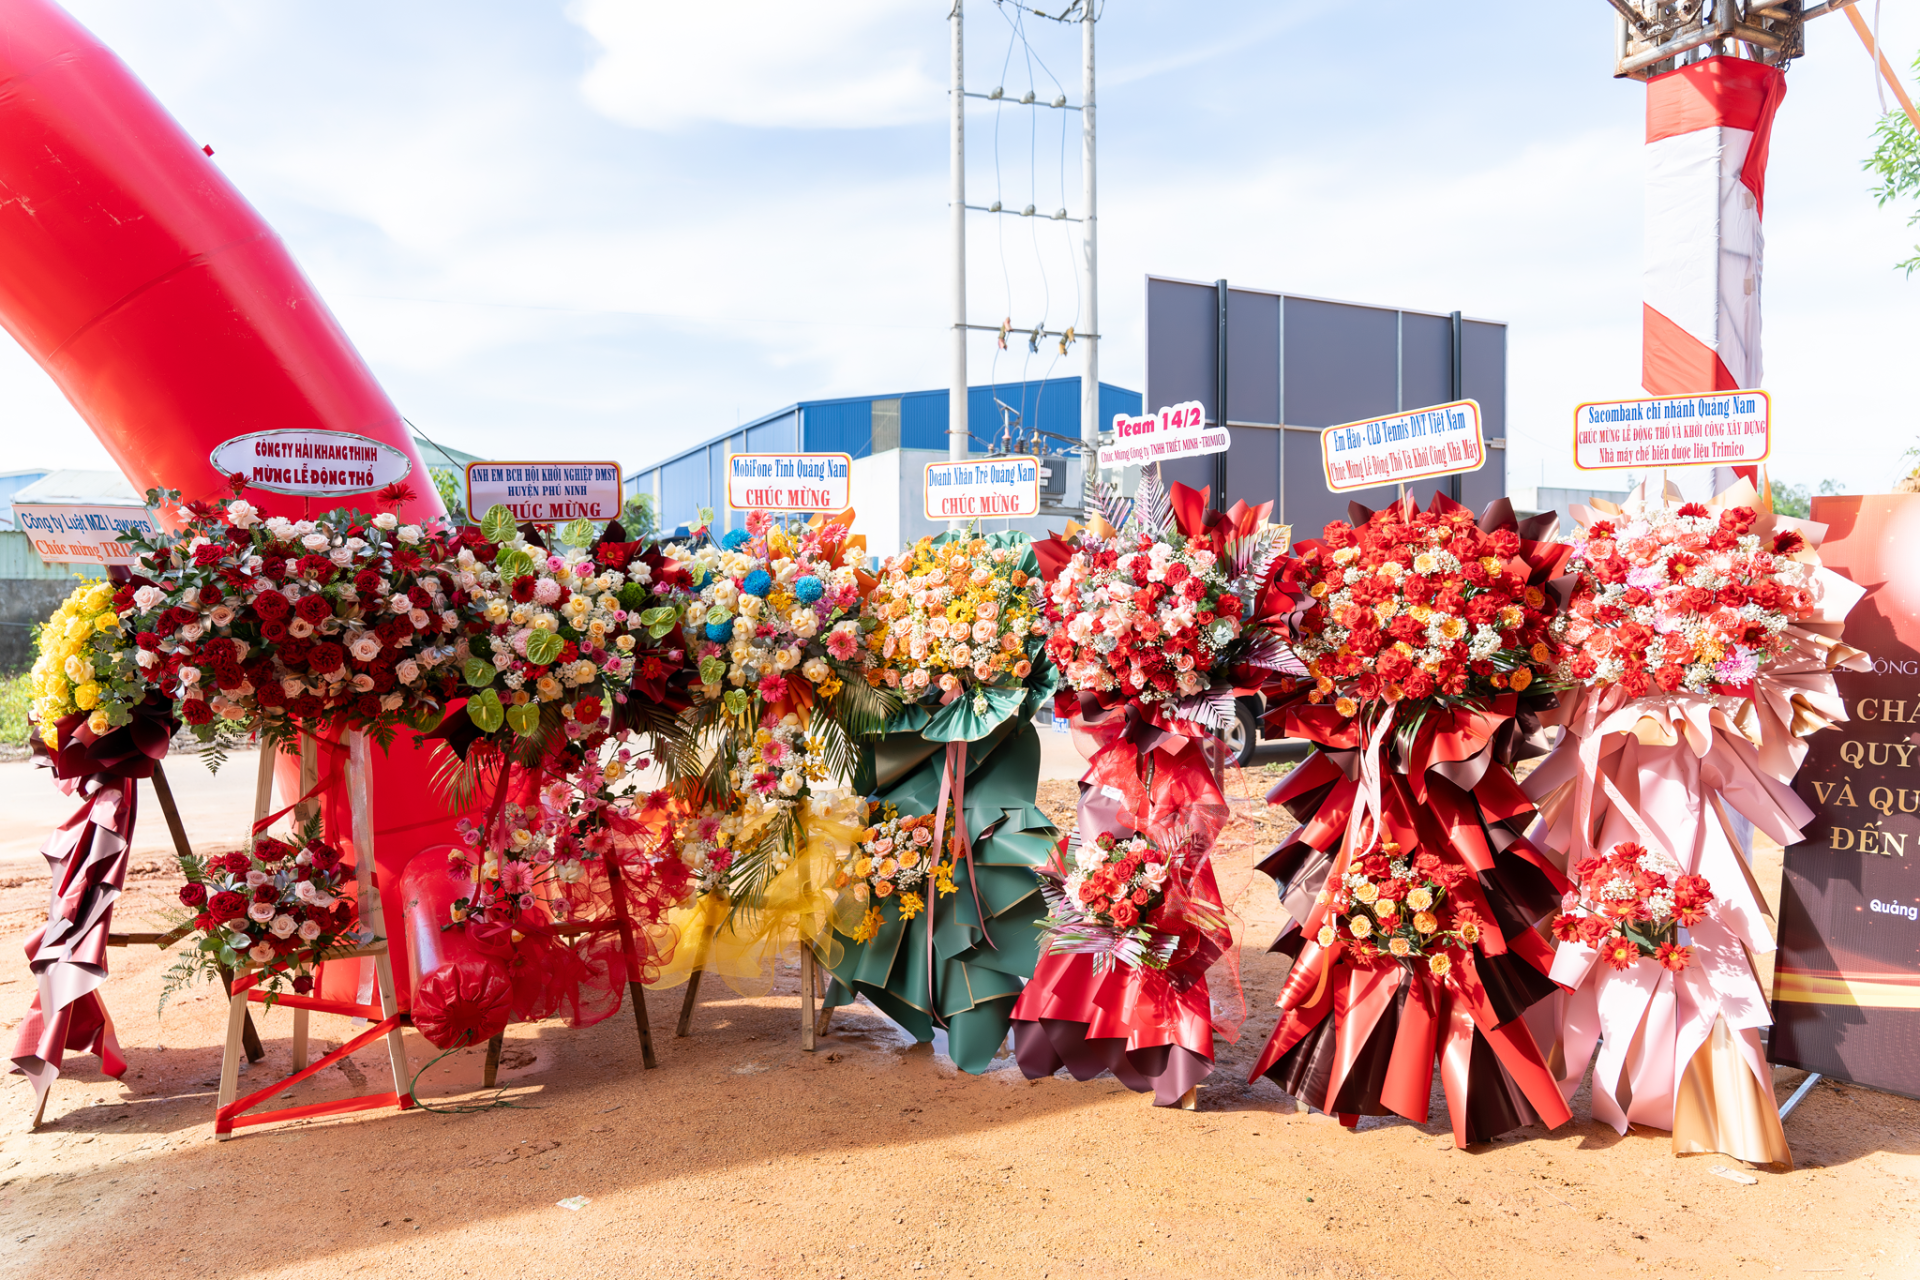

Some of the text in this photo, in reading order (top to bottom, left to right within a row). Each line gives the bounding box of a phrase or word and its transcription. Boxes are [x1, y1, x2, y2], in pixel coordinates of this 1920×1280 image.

[1588, 396, 1756, 424] Sacombank chi nhánh Quảng Nam
[1117, 407, 1201, 438] Team 14/2
[1333, 431, 1346, 452] Em
[1346, 427, 1361, 449] Hào
[1366, 423, 1382, 446] CLB
[1382, 418, 1409, 442] Tennis
[1410, 414, 1427, 438] DNT
[1428, 412, 1445, 436] Việt
[1445, 409, 1466, 431] Nam
[1579, 419, 1765, 444] CHÚC MỪNG LỄ ĐỘNG THỔ VÀ KHỞI CÔNG XÂY DỰNG
[255, 437, 377, 464] CÔNG TY HẢI KHANG THỊNH
[1100, 450, 1114, 463] Chúc
[1143, 445, 1149, 460] ty
[1150, 442, 1165, 455] TNHH
[1182, 437, 1199, 450] MINH
[1330, 462, 1346, 481] Chúc
[1345, 459, 1364, 481] Mừng
[1363, 455, 1372, 476] Lễ
[1371, 455, 1390, 477] Động
[1388, 449, 1403, 472] Thổ
[1402, 449, 1413, 469] Và
[1429, 444, 1448, 467] Công
[1446, 441, 1462, 462] Nhà
[1461, 439, 1477, 462] Máy
[1599, 447, 1614, 463] Nhà
[1617, 447, 1633, 464] máy
[1636, 445, 1650, 461] chế
[1652, 444, 1669, 461] biến
[1694, 442, 1709, 460] liệu
[1712, 441, 1744, 458] Trimico
[253, 462, 374, 488] MỪNG LỄ ĐỘNG THỔ
[472, 468, 489, 482] ANH
[492, 468, 504, 482] EM
[506, 468, 522, 482] BCH
[525, 466, 540, 484] HỘI
[564, 466, 593, 484] NGHIỆP
[595, 468, 616, 481] ĐMST
[733, 459, 847, 481] MobiFone Tỉnh Quảng Nam
[929, 463, 1035, 487] Doanh Nhân Trẻ Quảng Nam
[508, 483, 587, 498] HUYỆN PHÚ NINH
[746, 485, 830, 507] CHÚC MỪNG
[942, 491, 1019, 514] CHÚC MỪNG
[504, 499, 601, 519] HÚC MỪNG
[21, 513, 54, 533] Công
[49, 514, 65, 533] ty
[61, 514, 88, 534] Luật
[35, 539, 69, 555] Chúc
[1872, 656, 1918, 676] ỘNG
[1840, 736, 1917, 769] QUÝ
[1811, 776, 1920, 816] VÀ QU
[1829, 820, 1909, 857] ĐẾN
[1870, 898, 1918, 921] Quảng
